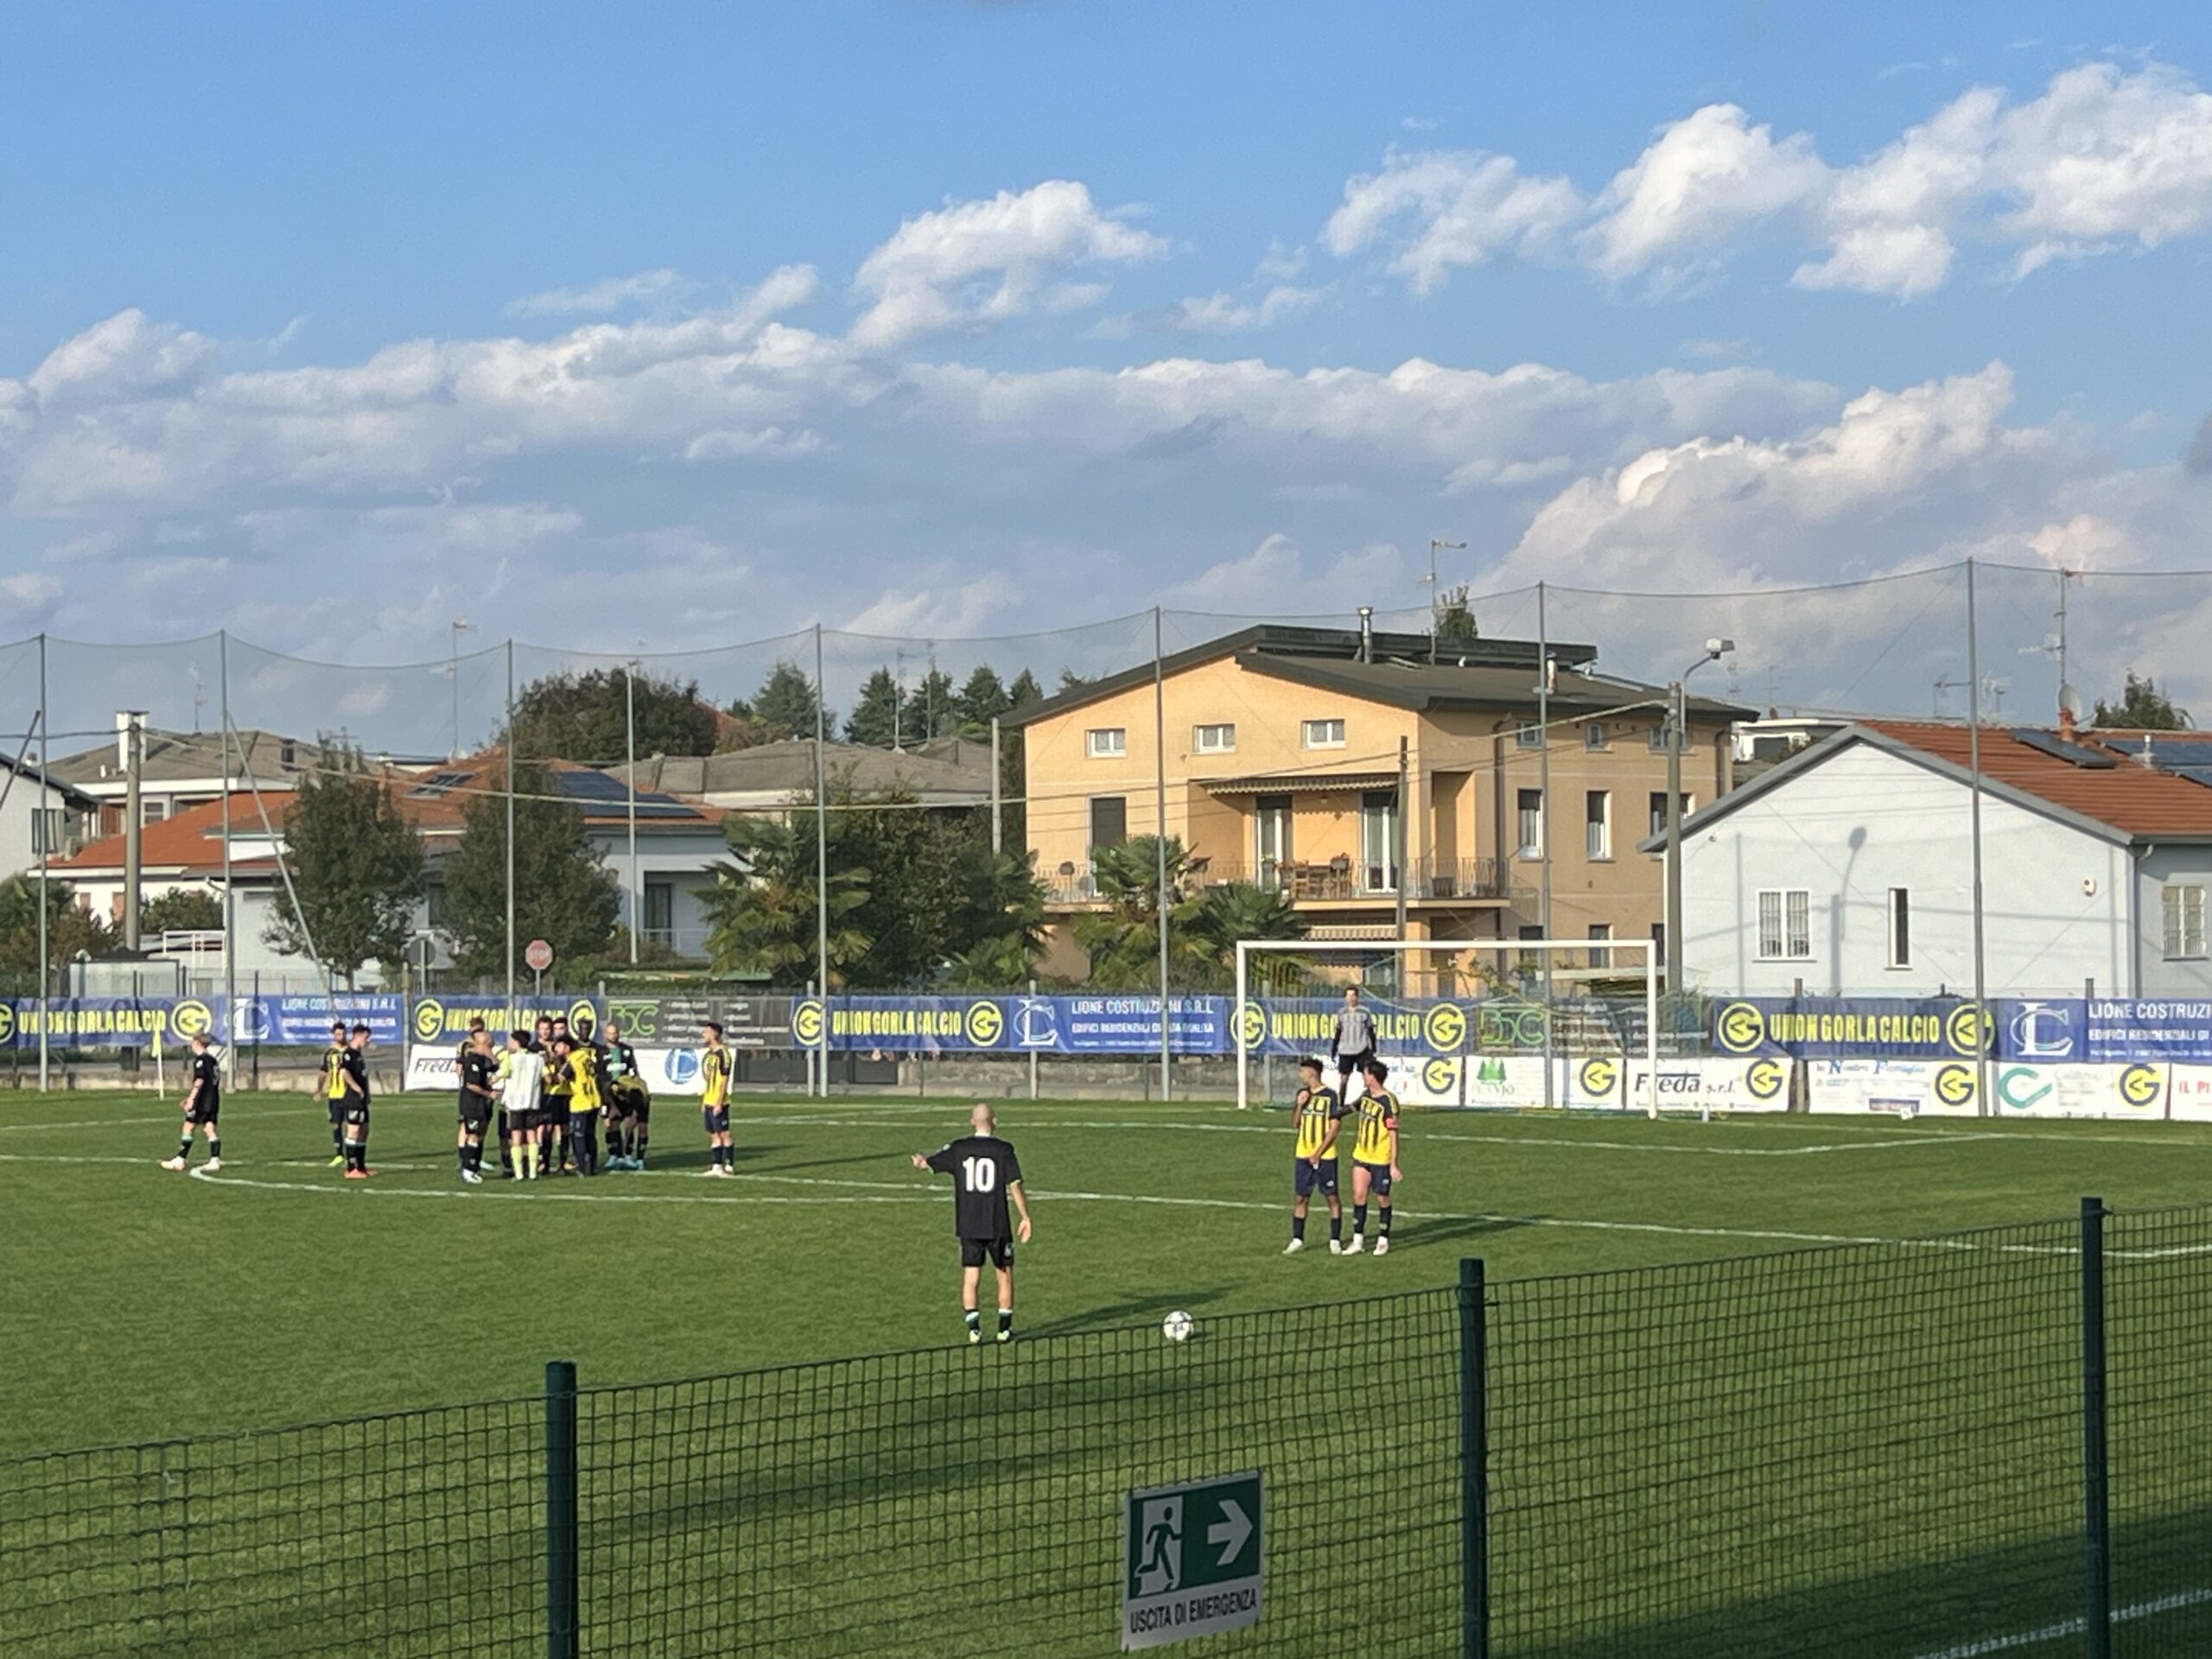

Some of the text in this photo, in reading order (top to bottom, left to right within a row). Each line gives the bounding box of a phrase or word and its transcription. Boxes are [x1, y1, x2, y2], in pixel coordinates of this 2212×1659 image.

[1071, 1001, 1103, 1014] LIONE
[2088, 1002, 2211, 1020] LIONE COSTRUZI
[19, 1010, 65, 1034] UNON
[833, 1010, 962, 1035] UNION GORLA CALCIO
[1271, 1013, 1319, 1039] UNION
[1770, 1014, 1940, 1044] UNION GORLA CALCIO
[1635, 1071, 1701, 1093] Feda
[962, 1156, 995, 1192] 10
[1130, 1588, 1257, 1633] USCITA DI EMERGENZA
